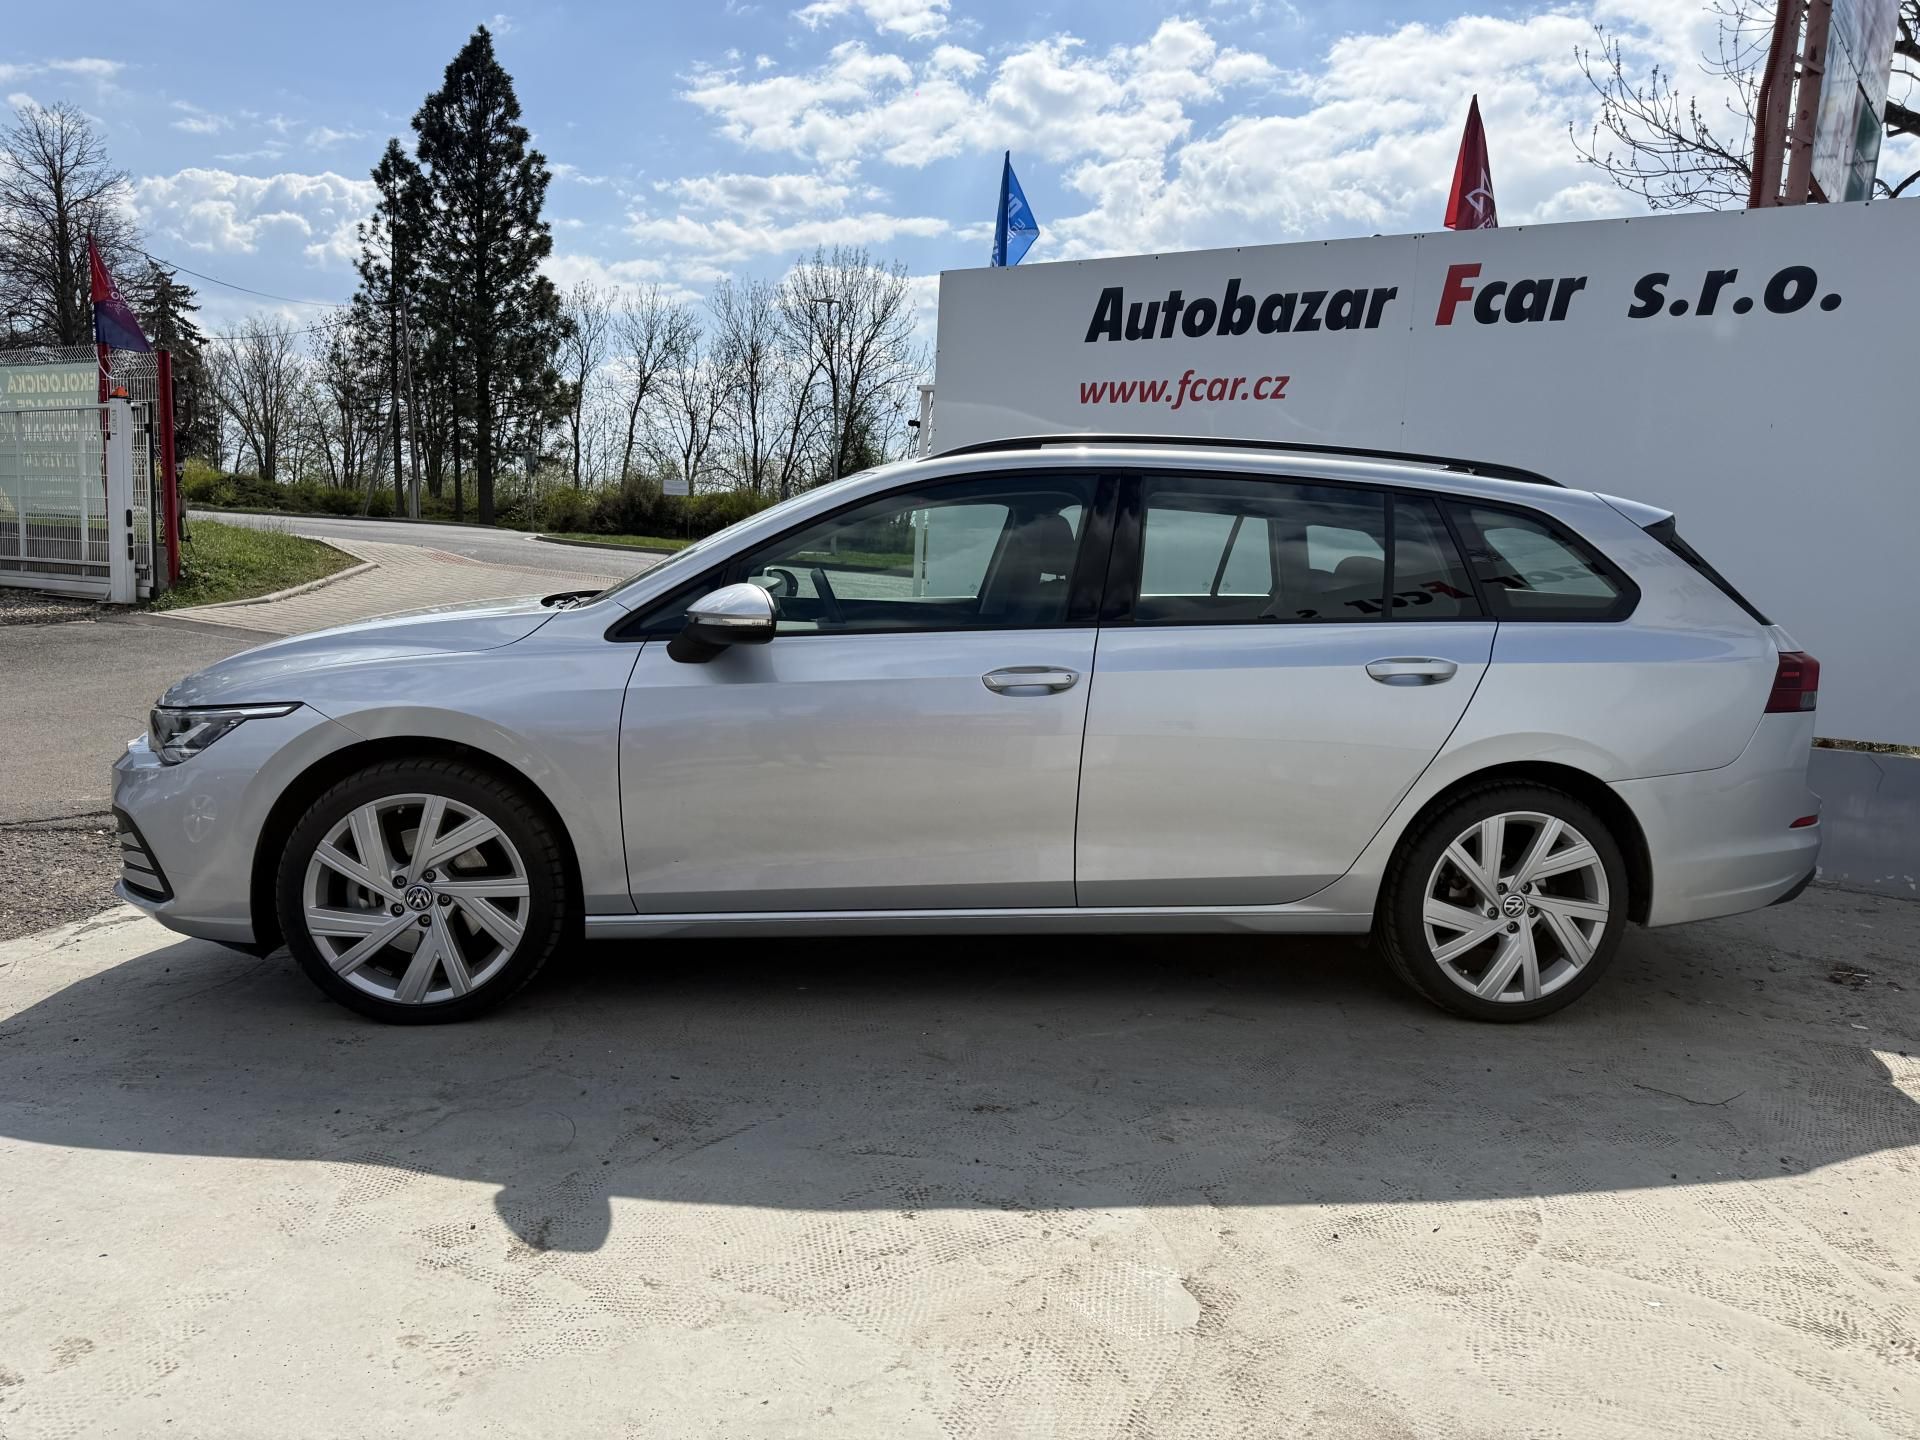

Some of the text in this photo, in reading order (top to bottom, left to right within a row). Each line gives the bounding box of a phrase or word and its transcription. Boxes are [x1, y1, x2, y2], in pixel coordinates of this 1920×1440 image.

[1084, 263, 1843, 343] Autobazar Fcar s.r.o.
[1080, 370, 1290, 410] www.fcar.cz
